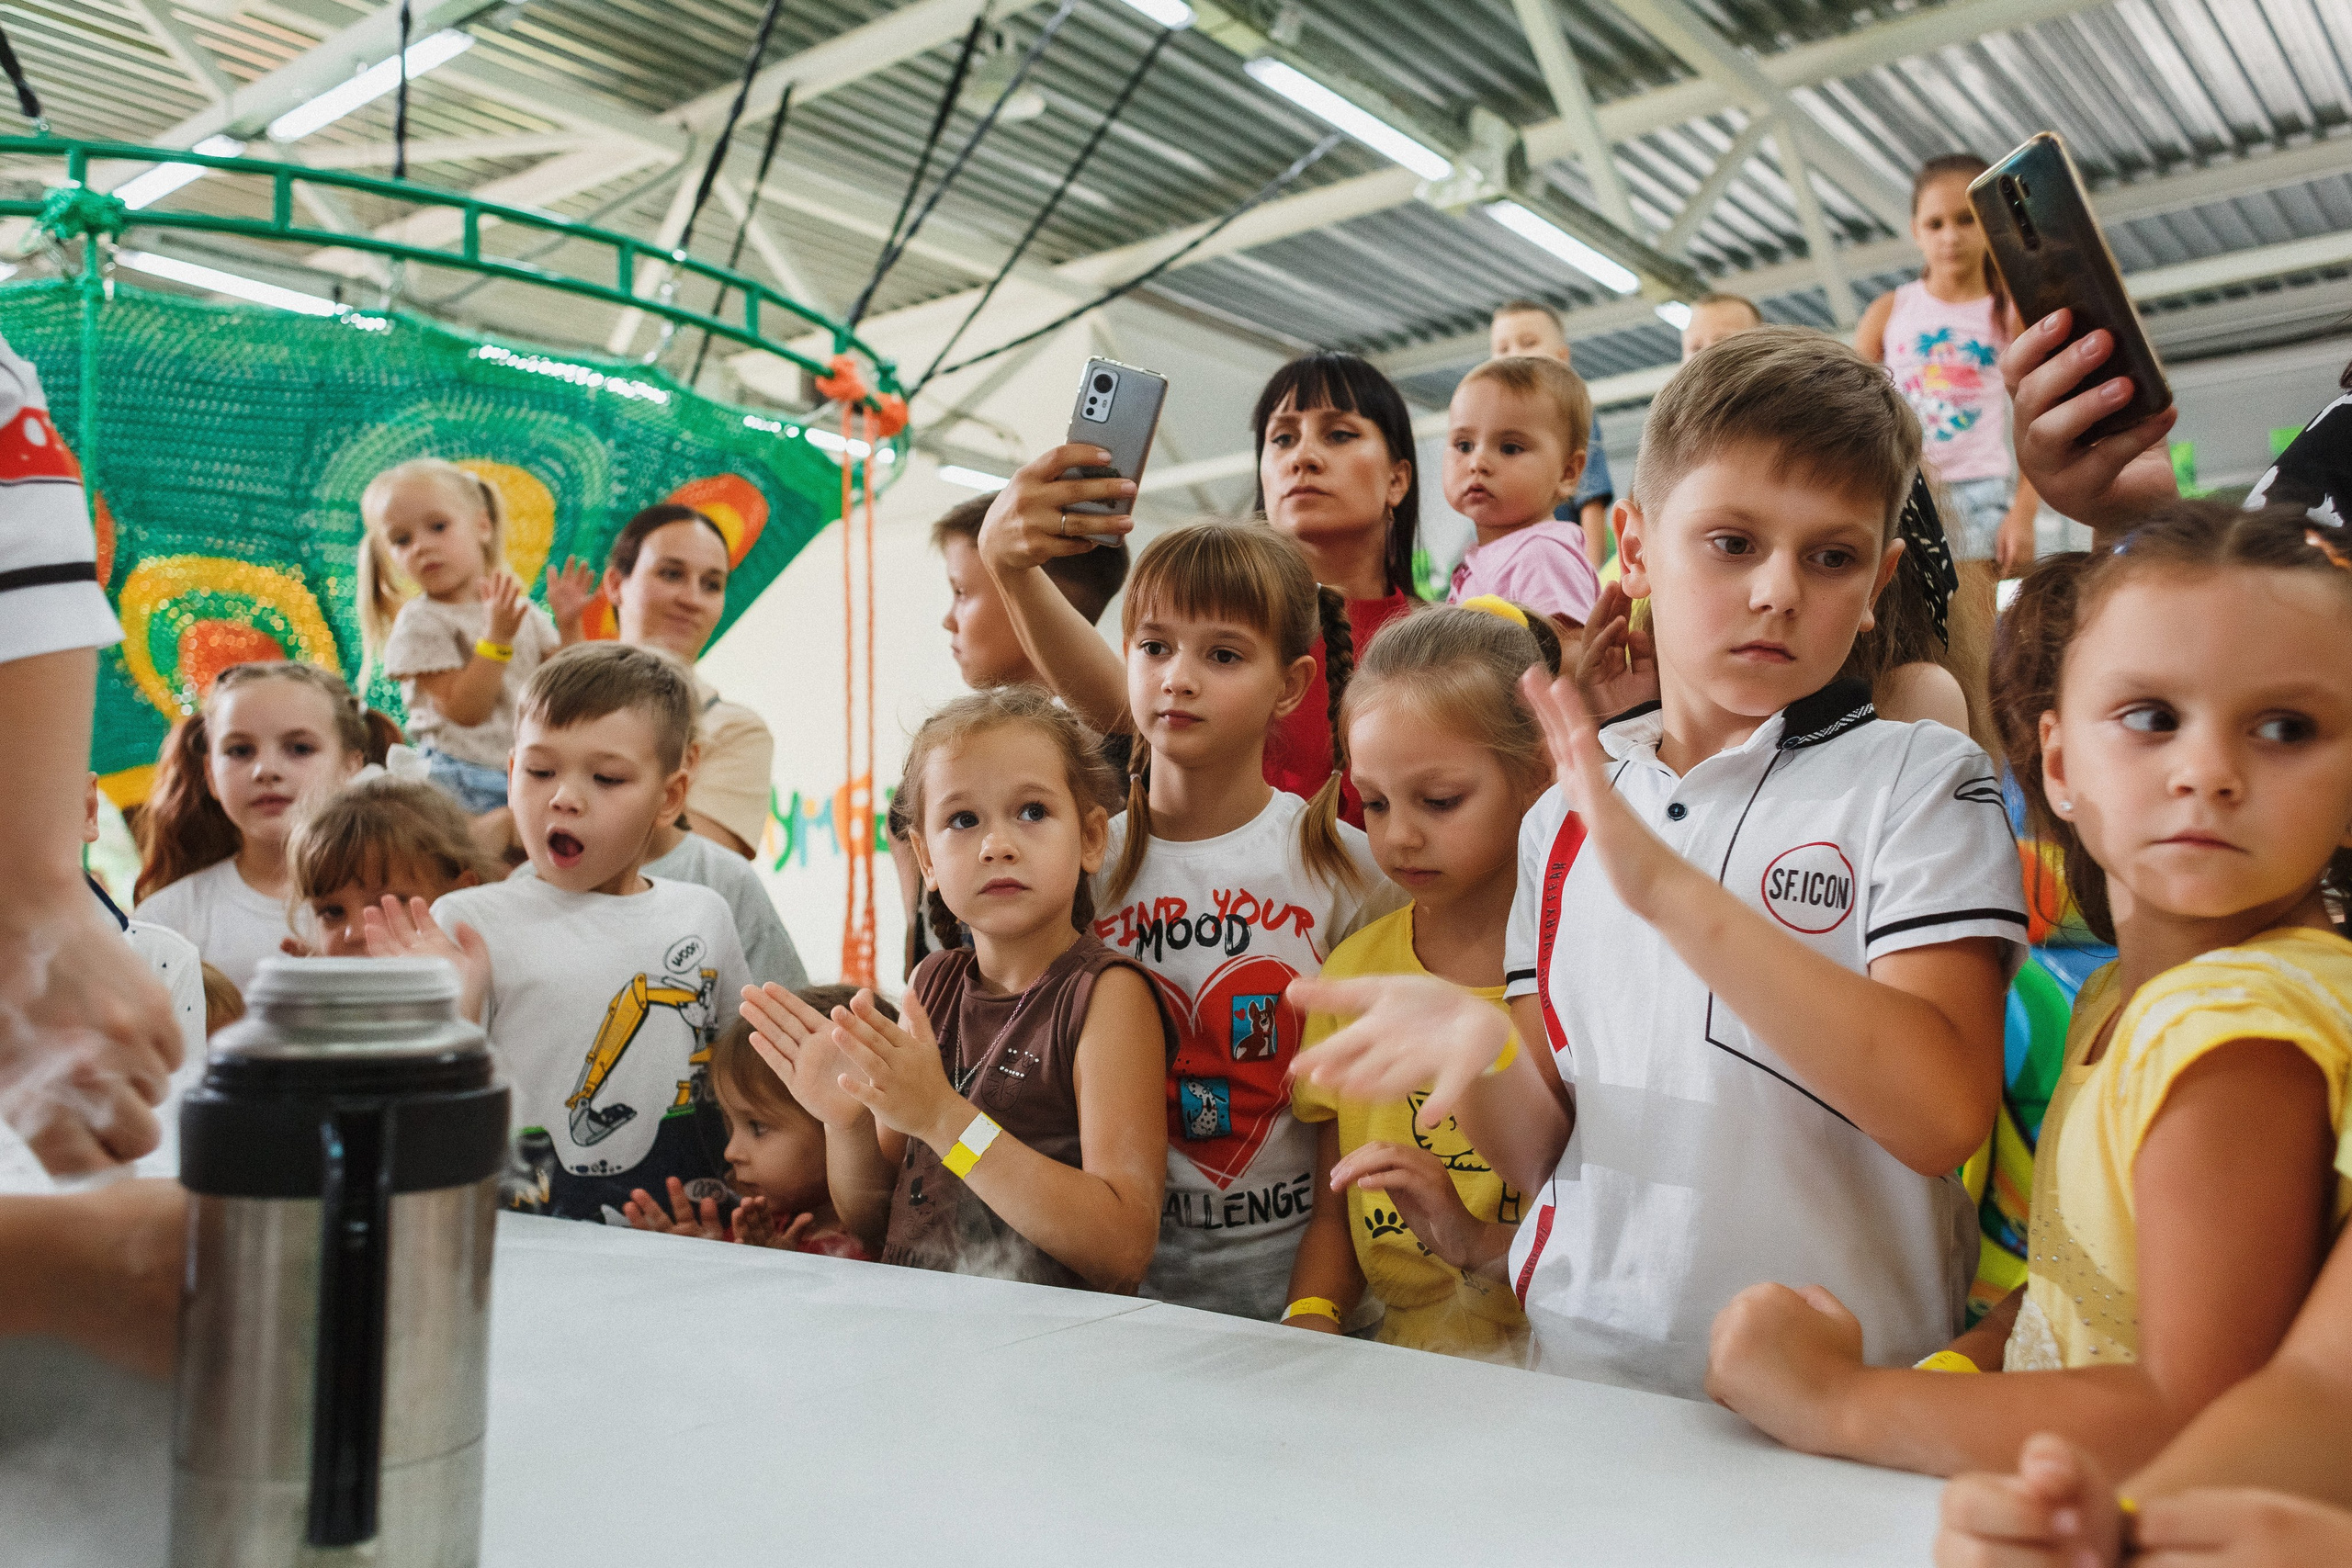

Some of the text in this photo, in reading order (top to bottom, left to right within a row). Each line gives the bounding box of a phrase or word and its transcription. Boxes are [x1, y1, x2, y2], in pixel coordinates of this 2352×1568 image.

[1769, 868, 1849, 909] SF.ICON
[1093, 888, 1323, 964] FIND YOUR
[1135, 912, 1252, 964] MOOD
[1162, 1172, 1313, 1229] ALLENGE
